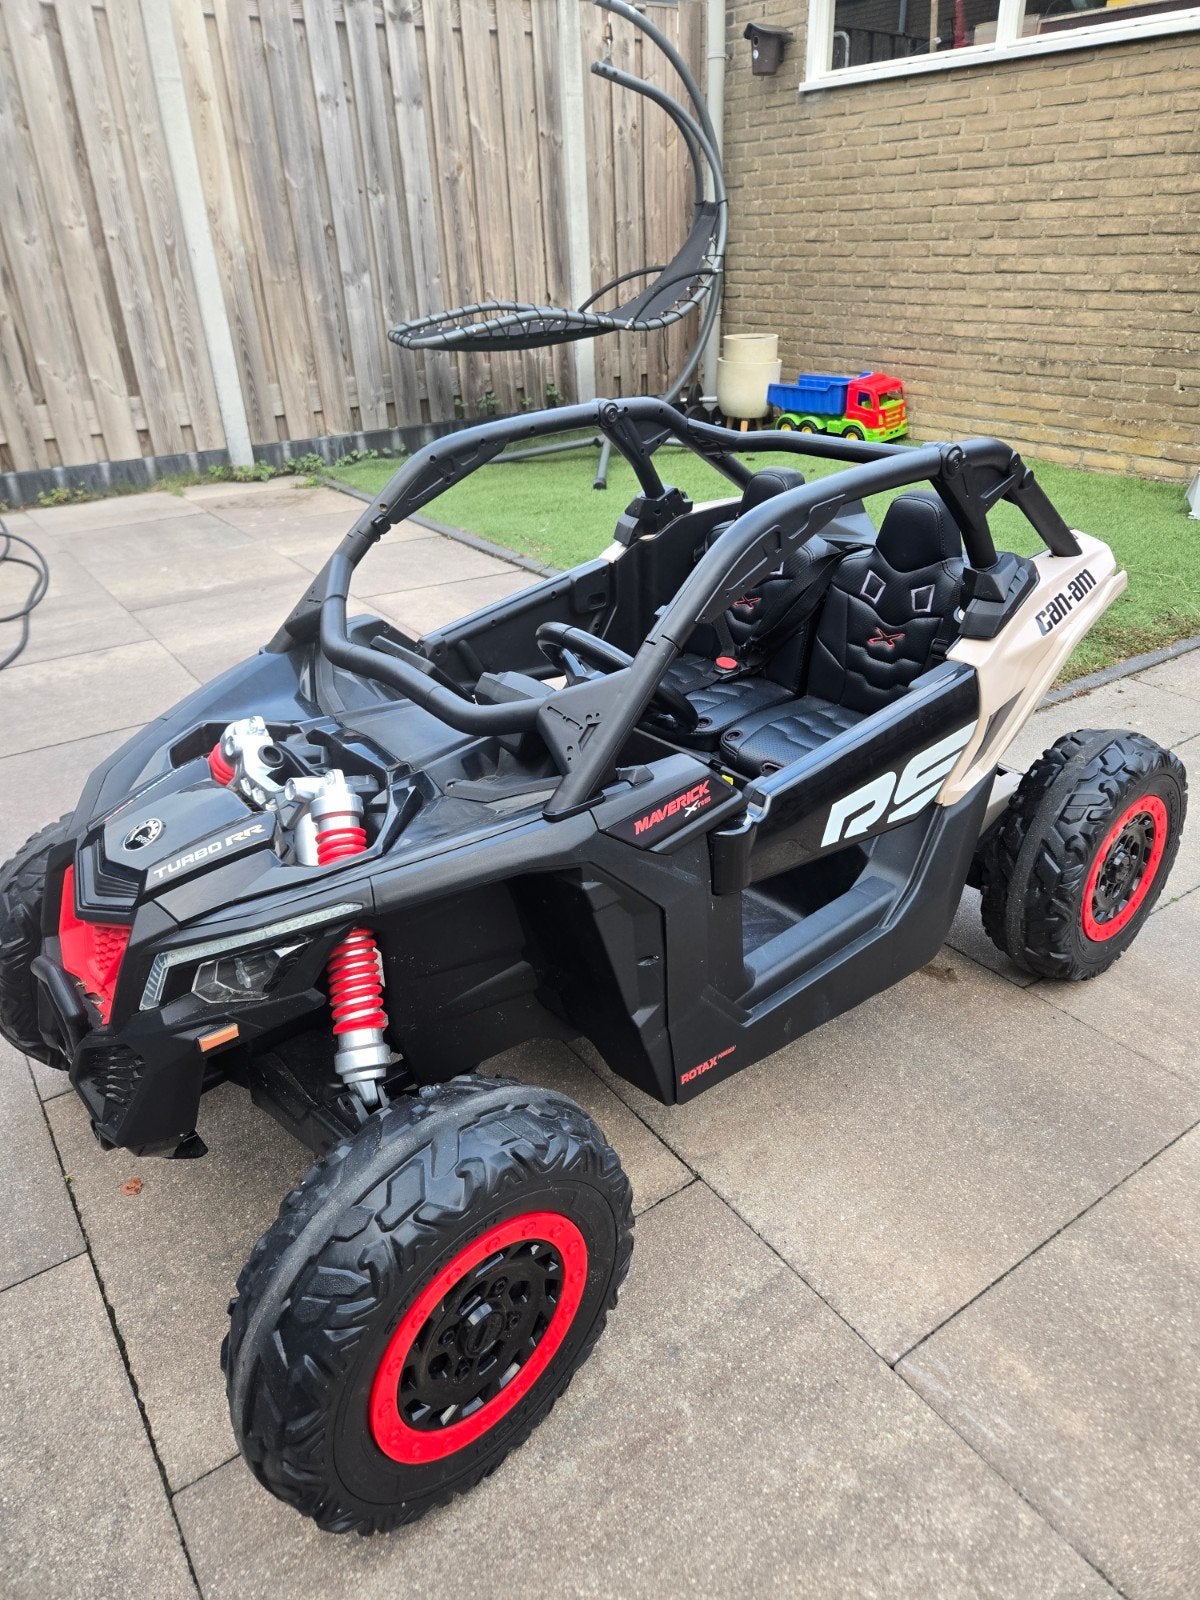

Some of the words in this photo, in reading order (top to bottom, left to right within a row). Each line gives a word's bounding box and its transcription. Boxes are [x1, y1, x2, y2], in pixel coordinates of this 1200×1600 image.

[634, 780, 710, 836] MAVERICK
[153, 841, 222, 879] TURBO
[226, 824, 266, 847] RR
[680, 1055, 718, 1085] ROTAX
